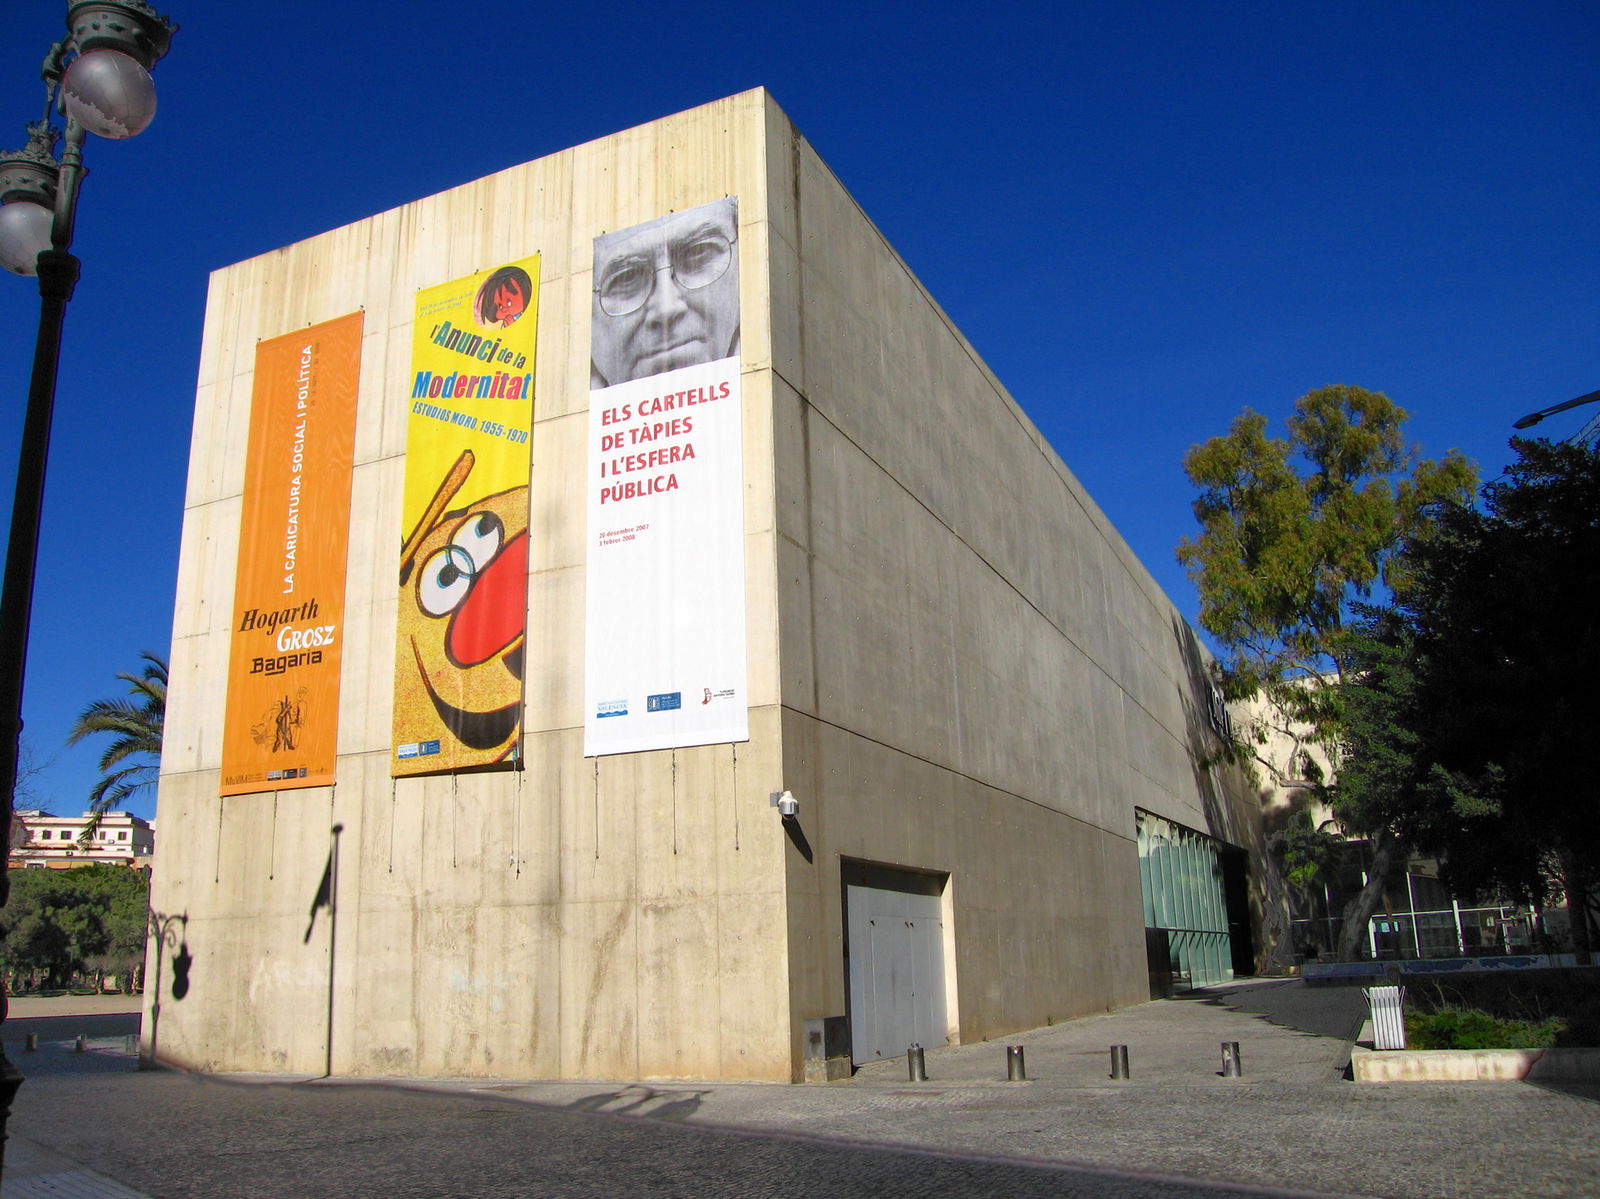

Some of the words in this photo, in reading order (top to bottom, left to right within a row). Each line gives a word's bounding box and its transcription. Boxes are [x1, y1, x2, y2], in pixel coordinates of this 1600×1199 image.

[497, 347, 512, 364] de
[513, 353, 527, 369] la
[297, 344, 312, 410] POLÍTICA
[411, 370, 532, 400] Modernitat
[602, 404, 632, 426] ELS
[638, 381, 730, 416] CARTELLS
[412, 401, 452, 422] ESTUDIOS
[481, 420, 529, 444] 1955-1970
[601, 432, 625, 452] DE
[629, 416, 693, 445] TÀPIES
[292, 420, 306, 473] SOCIAL
[601, 462, 606, 478] I
[612, 443, 696, 476] L'ESFERA
[600, 473, 679, 504] PÚBLICA
[284, 475, 302, 570] CARICATURA
[607, 527, 634, 537] desembre
[635, 523, 650, 532] 2007
[603, 537, 621, 546] febrer
[622, 534, 636, 542] 2008
[283, 573, 295, 594] LA
[238, 598, 319, 635] Hogarth
[277, 626, 336, 652] GROSZ
[249, 649, 322, 676] Bagaria
